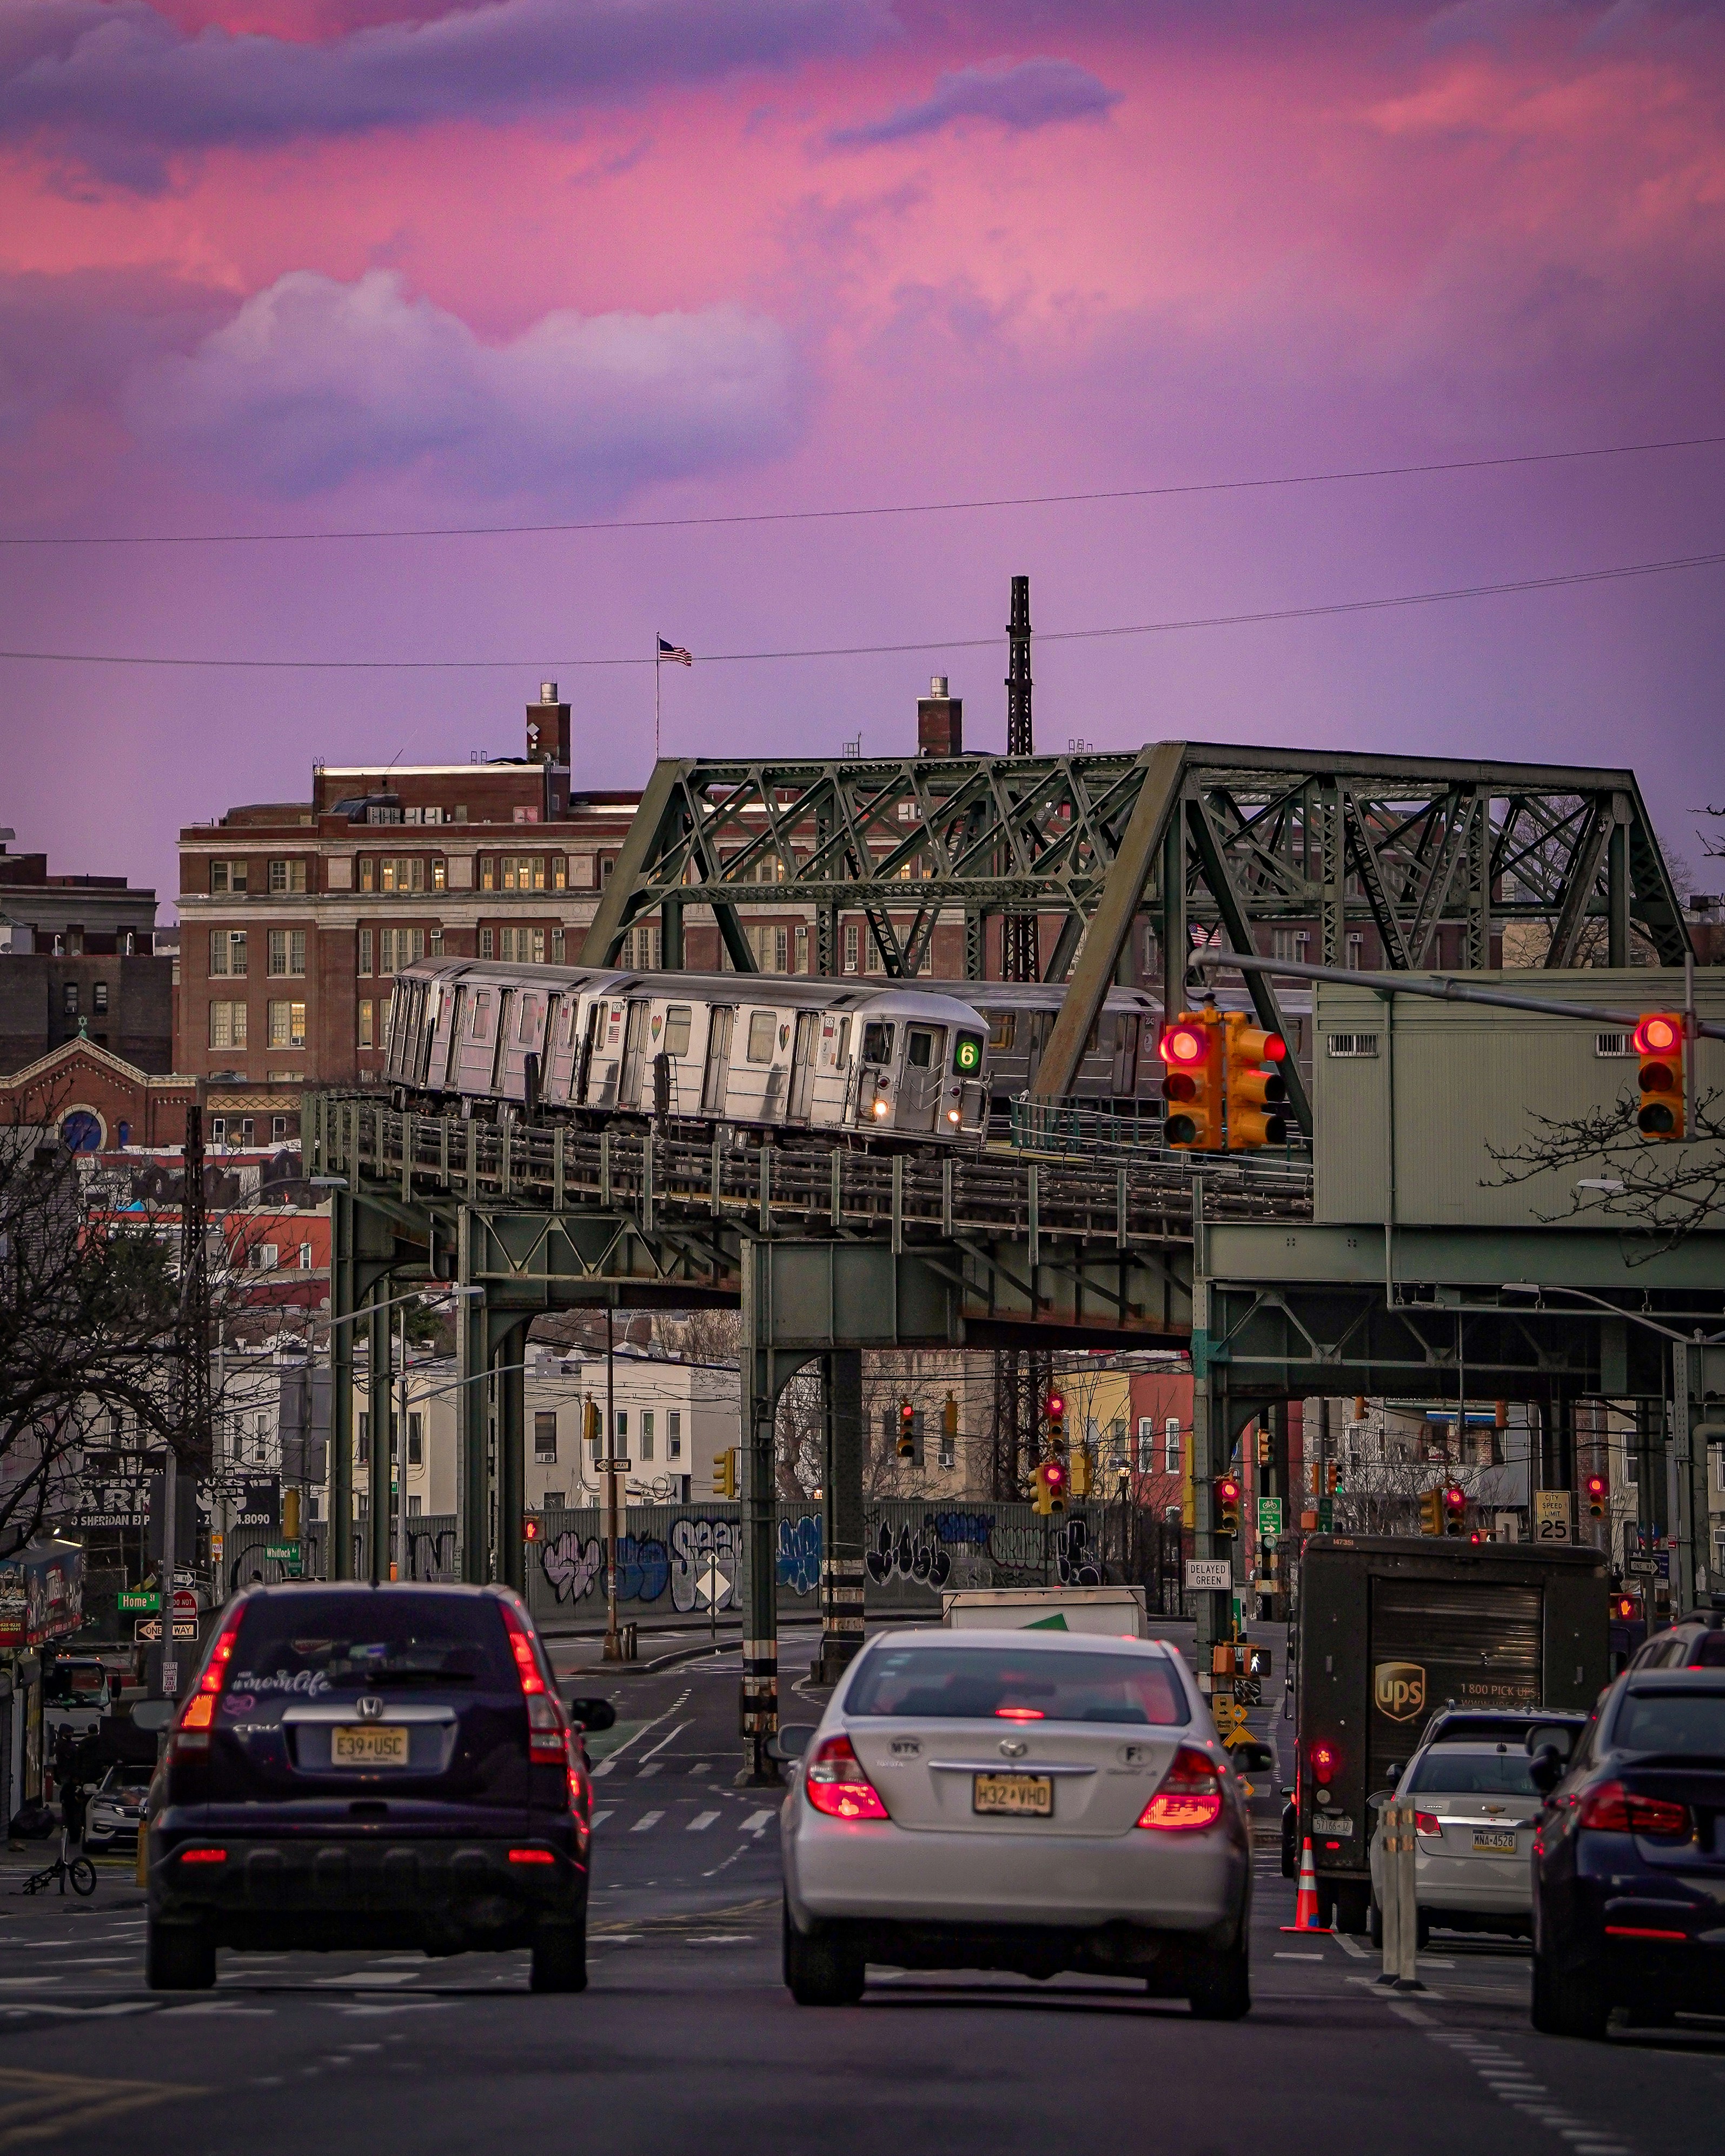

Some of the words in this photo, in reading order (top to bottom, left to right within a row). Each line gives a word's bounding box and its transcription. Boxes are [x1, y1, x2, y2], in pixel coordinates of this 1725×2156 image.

[961, 1046, 974, 1065] 6
[1541, 1520, 1567, 1539] 25
[267, 1547, 291, 1558] Whitlock
[1191, 1565, 1225, 1574] DELAYED
[1196, 1575, 1221, 1585] GREEN
[123, 1595, 147, 1607] Home
[174, 1626, 191, 1634] WAY
[1461, 1683, 1465, 1693] 1
[1469, 1684, 1488, 1694] 800
[1491, 1685, 1514, 1696] PICK
[1378, 1680, 1422, 1712] ups
[1474, 1834, 1489, 1846] MNA
[1493, 1835, 1513, 1847] 4528
